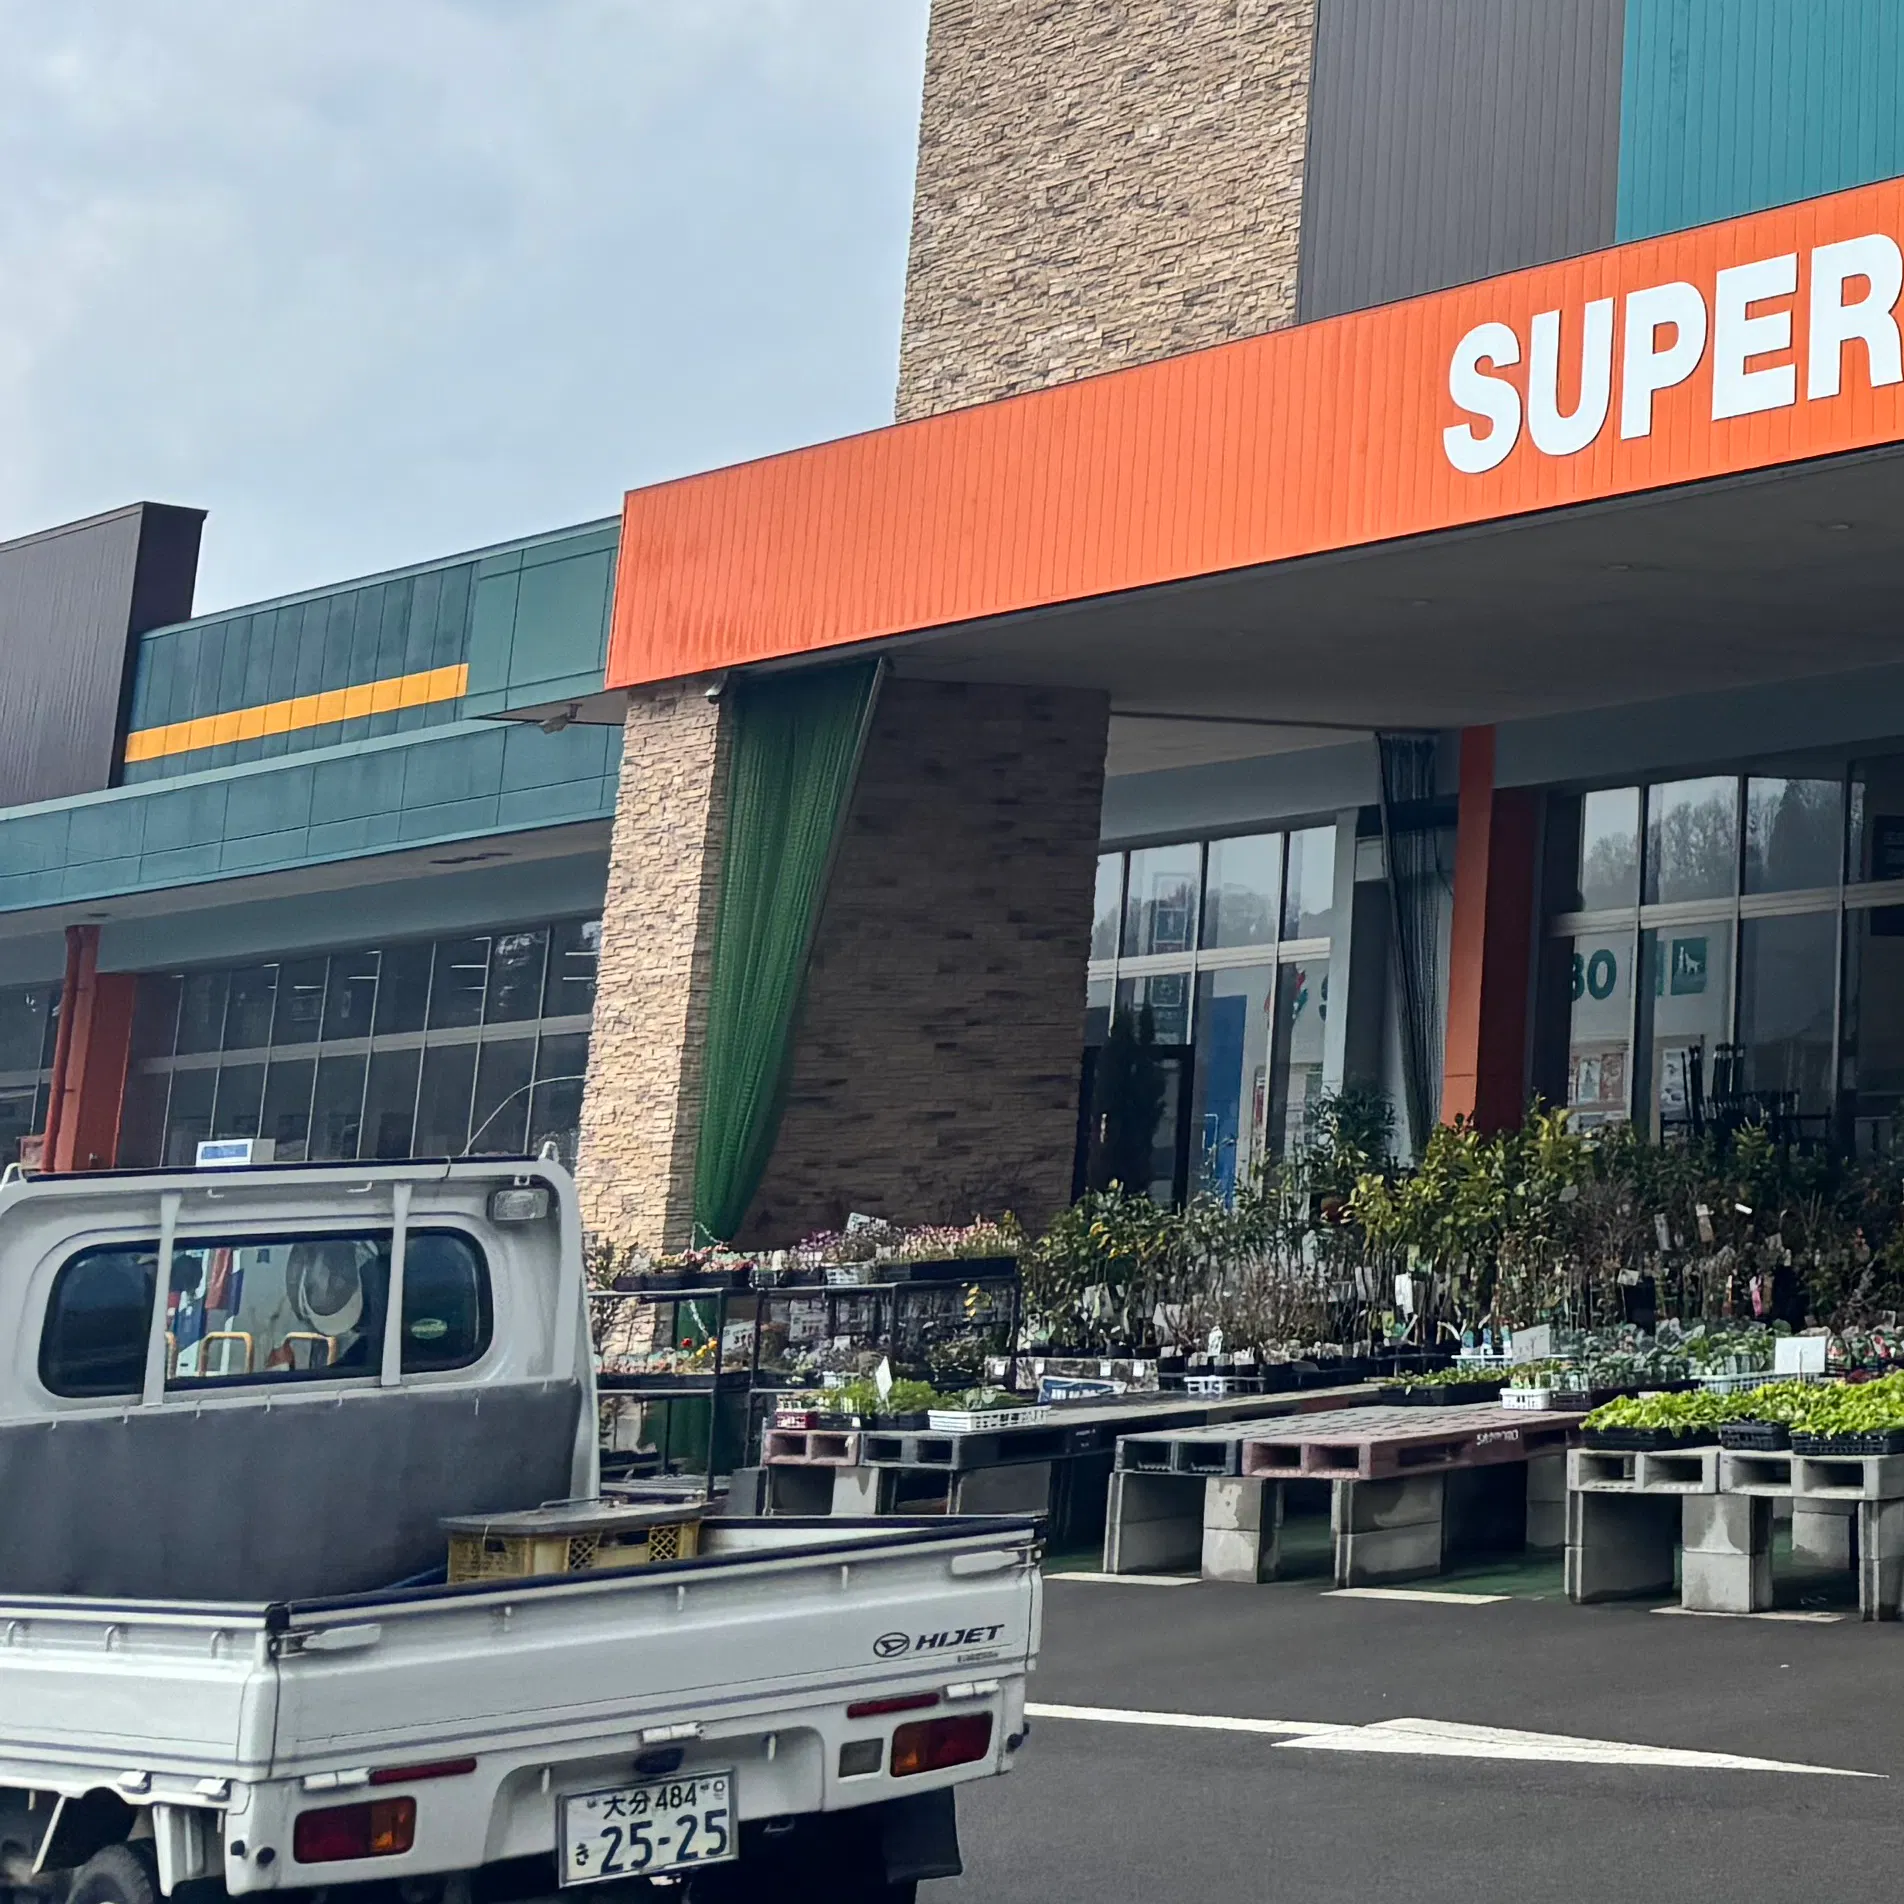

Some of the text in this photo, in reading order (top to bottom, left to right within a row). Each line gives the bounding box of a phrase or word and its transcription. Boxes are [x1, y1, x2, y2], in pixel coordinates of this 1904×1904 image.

[915, 1624, 1005, 1650] HIJET
[603, 1782, 697, 1820] 大分 484
[600, 1808, 728, 1876] 25-25
